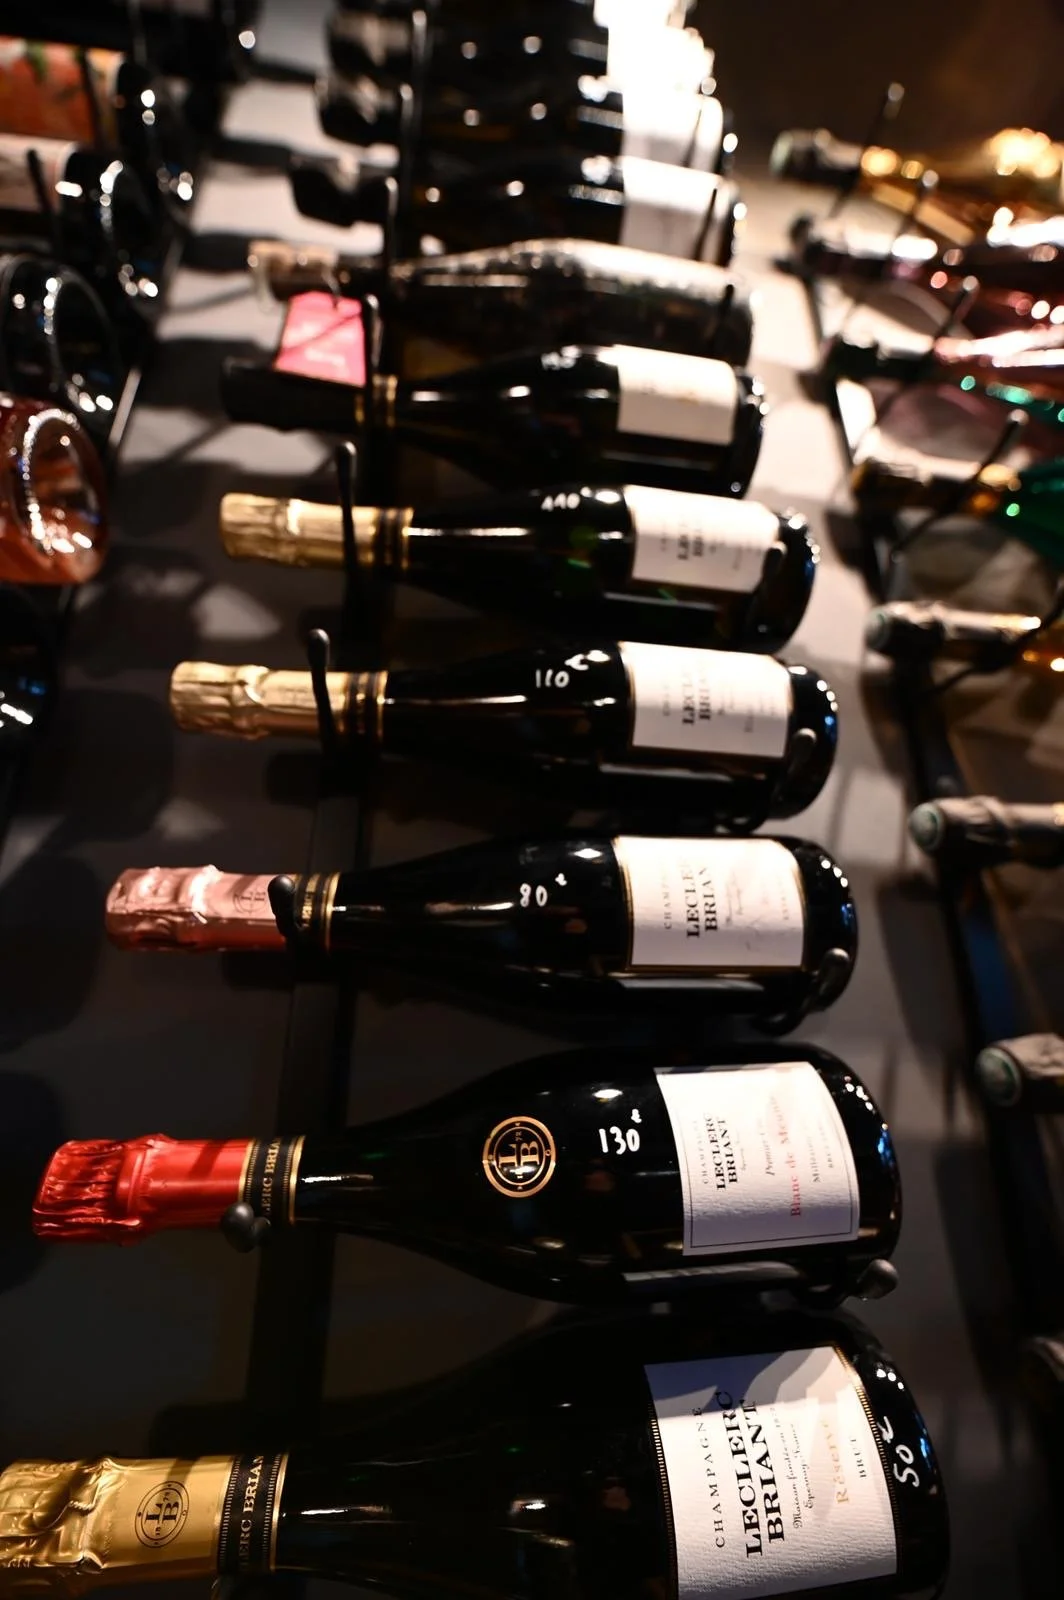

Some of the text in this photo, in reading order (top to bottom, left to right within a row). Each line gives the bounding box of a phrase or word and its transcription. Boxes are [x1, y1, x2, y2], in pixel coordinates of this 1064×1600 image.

[535, 669, 569, 688] 110
[520, 883, 548, 907] 80
[599, 1126, 640, 1155] 130
[704, 1113, 726, 1190] LECLERC
[716, 1118, 738, 1184] BRIANT
[789, 1175, 801, 1217] Blanc
[690, 1406, 726, 1549] CHAMPAGNE
[715, 1391, 763, 1558] LECLERC
[739, 1398, 785, 1543] BRIANT
[892, 1444, 920, 1488] 50
